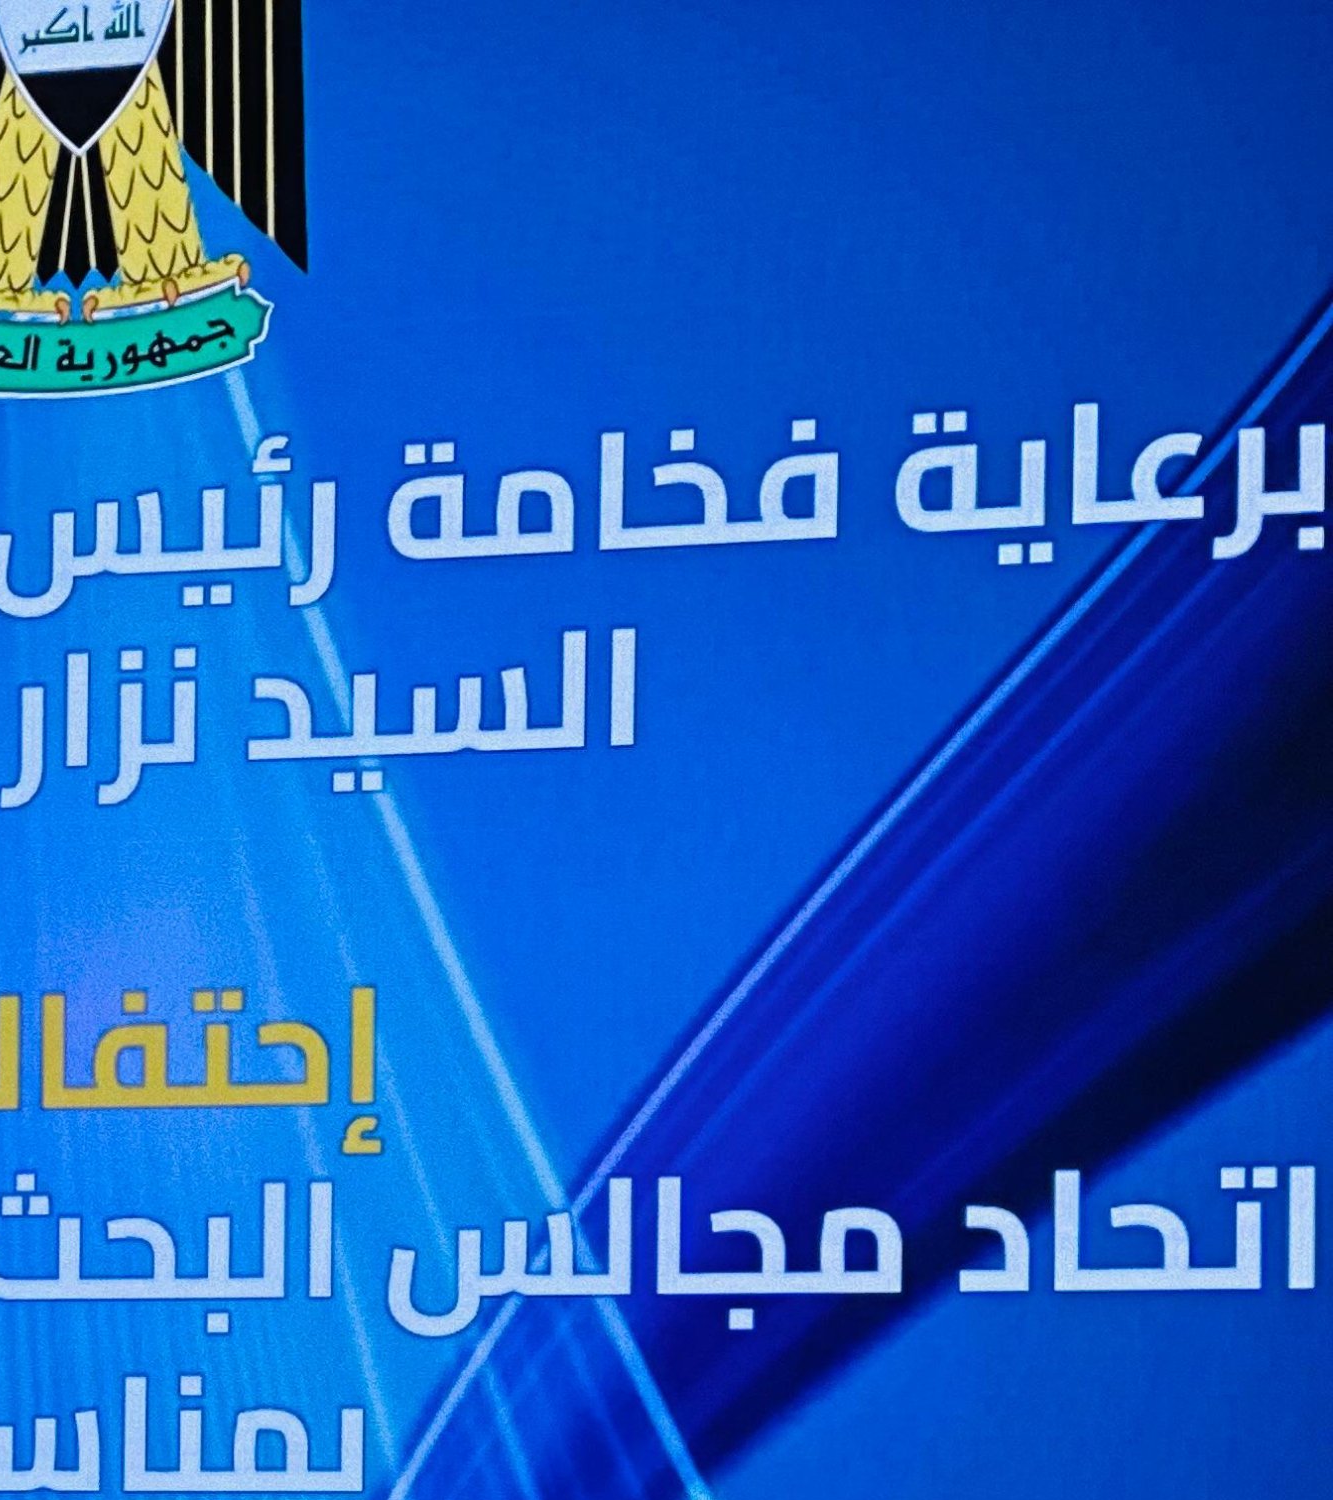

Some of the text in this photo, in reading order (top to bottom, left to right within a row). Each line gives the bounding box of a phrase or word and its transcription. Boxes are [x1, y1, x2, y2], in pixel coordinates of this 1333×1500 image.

[103, 0, 146, 41] الله
[56, 317, 236, 382] جمهورية
[387, 418, 839, 560] فخامة
[895, 402, 1326, 566] برعاية
[0, 647, 197, 809] نزار
[248, 627, 636, 793] السيد
[388, 1176, 903, 1337] مجالس
[958, 1165, 1316, 1293] اتحاد
